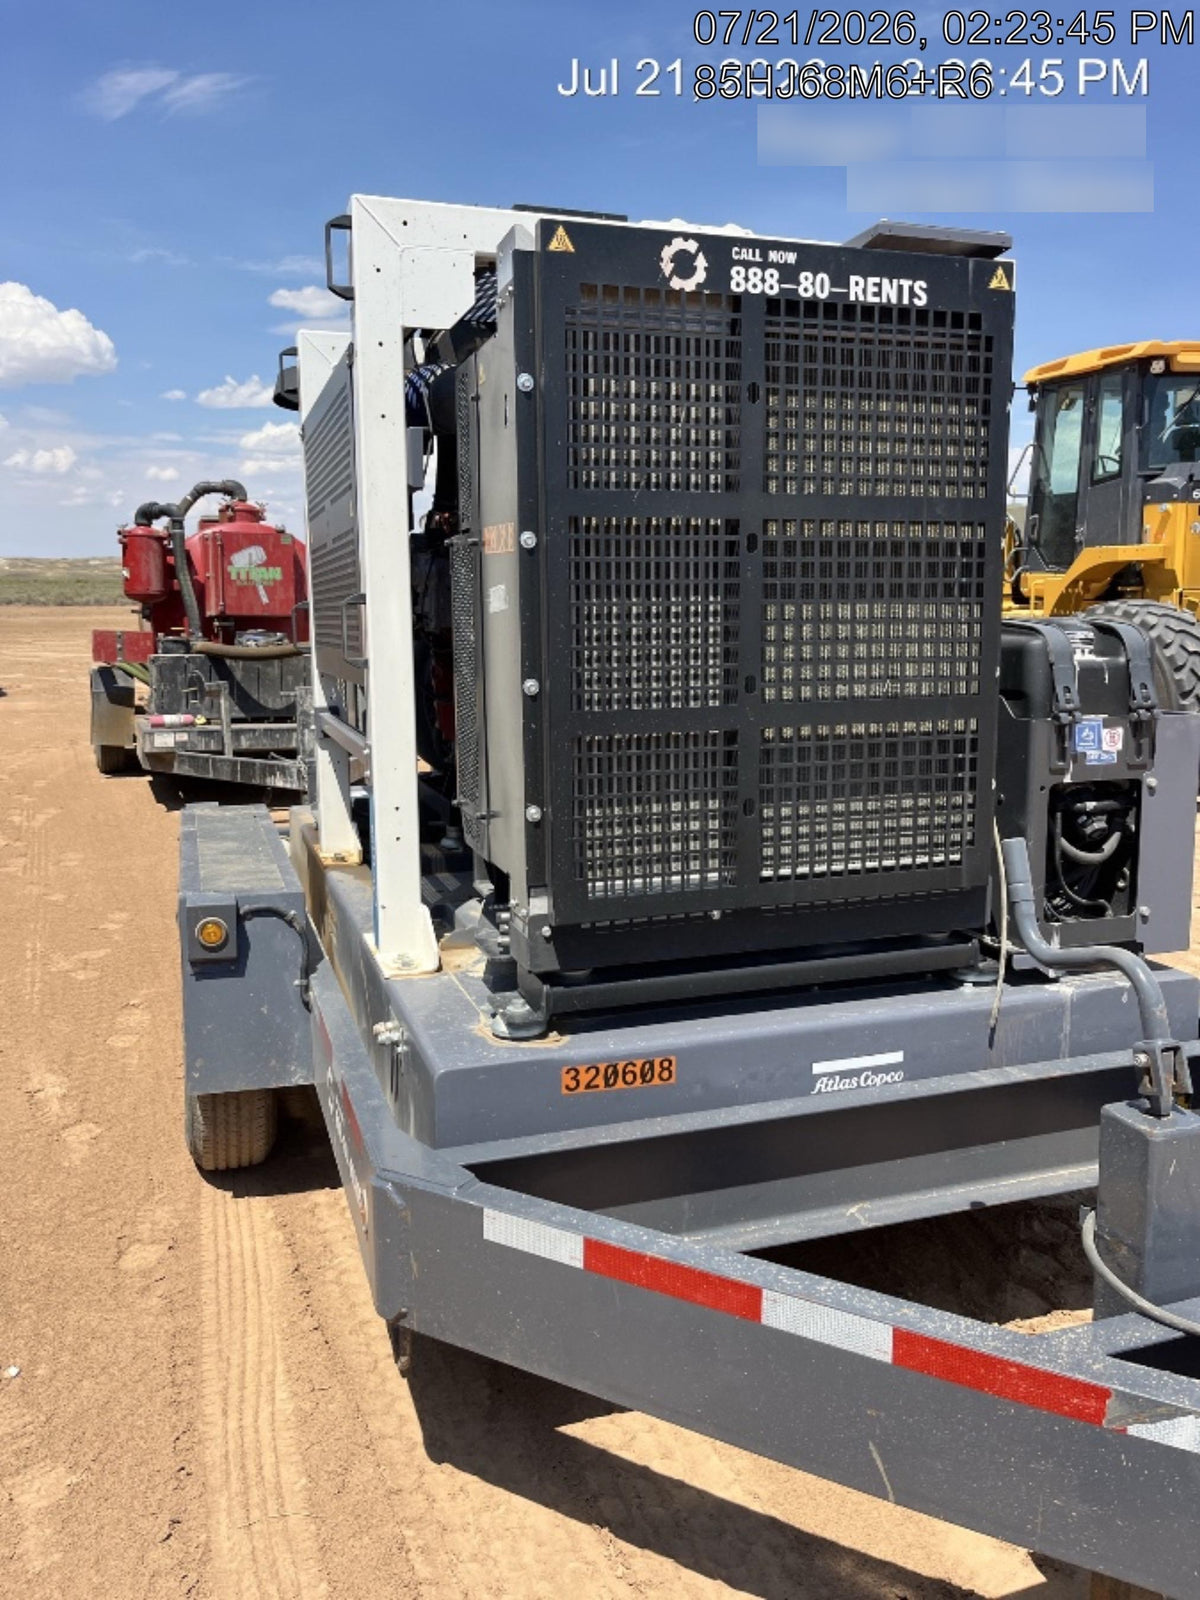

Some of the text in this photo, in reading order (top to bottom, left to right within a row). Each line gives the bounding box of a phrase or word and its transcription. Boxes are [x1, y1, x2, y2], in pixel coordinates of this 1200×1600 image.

[731, 246, 797, 265] CALL NOW
[564, 1057, 673, 1092] 320608
[810, 1070, 904, 1094] Atlas Copco
